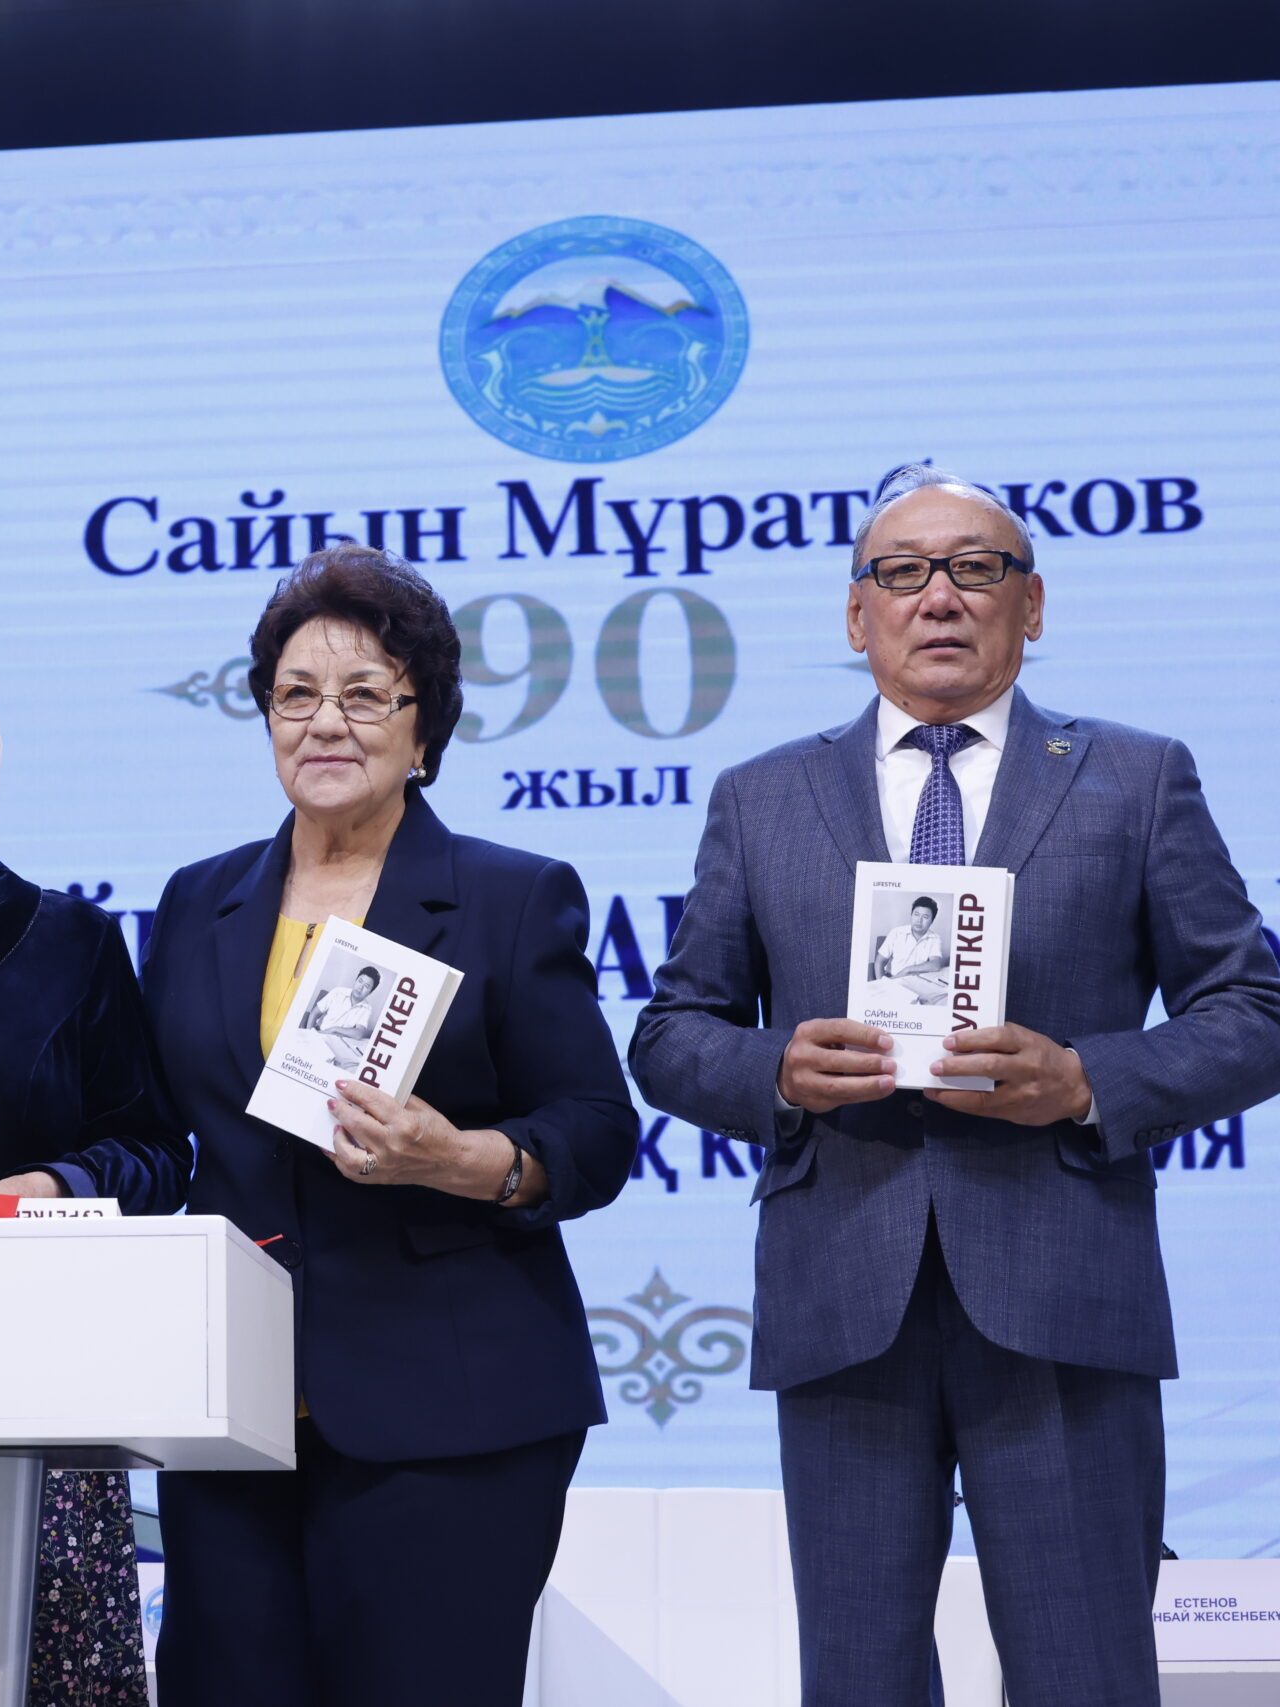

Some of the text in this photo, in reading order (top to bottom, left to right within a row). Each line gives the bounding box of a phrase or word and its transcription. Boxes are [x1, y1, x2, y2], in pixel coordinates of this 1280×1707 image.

[496, 458, 1203, 578] Мұратков
[452, 586, 738, 744] 90
[501, 765, 693, 810] жыл
[335, 938, 358, 951] LIFESTYLE
[951, 893, 985, 1033] УРЕТКЕР
[864, 1009, 898, 1018] САЙЫН
[358, 976, 419, 1088] РЕТКЕР
[284, 1052, 313, 1070] САЙЫН
[1153, 1610, 1190, 1622] НБАЙ
[1174, 1597, 1238, 1608] ЕСТЕНОВ
